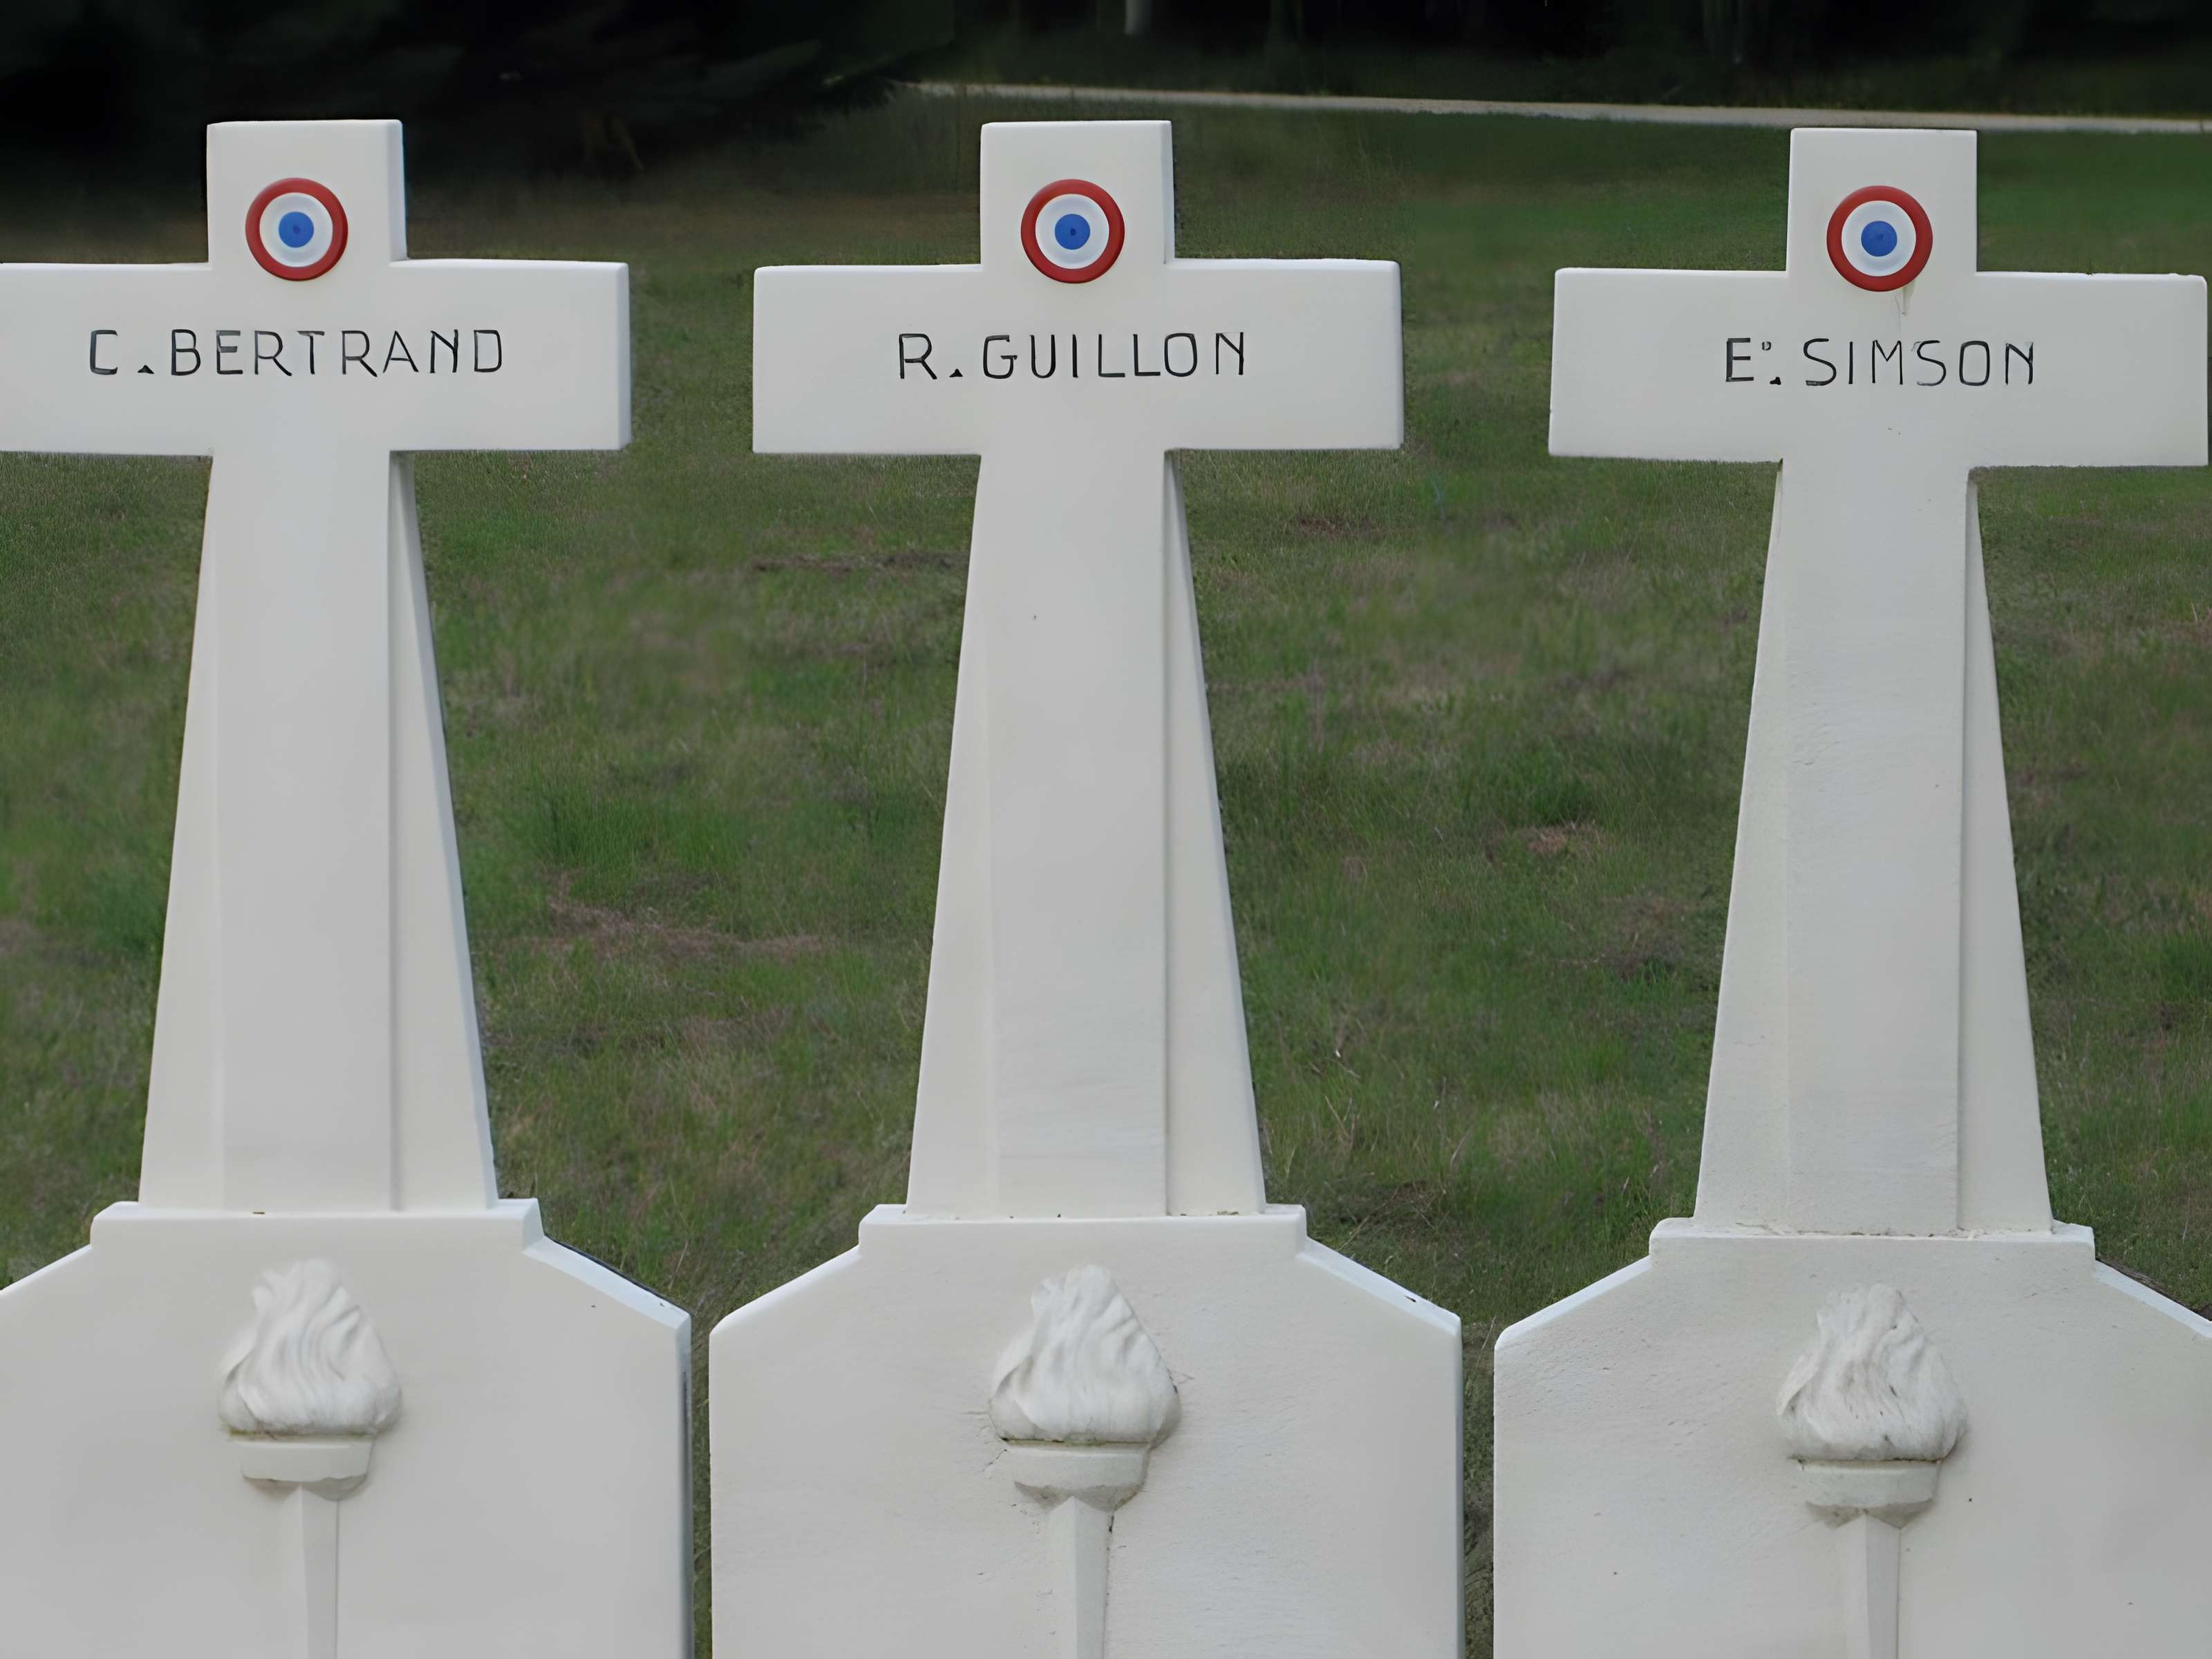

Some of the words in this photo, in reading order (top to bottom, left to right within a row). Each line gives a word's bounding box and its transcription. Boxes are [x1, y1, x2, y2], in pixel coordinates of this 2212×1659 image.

[171, 328, 503, 378] BERTRAND
[982, 331, 1244, 379] GUILLON
[1803, 337, 2034, 387] SIMSON
